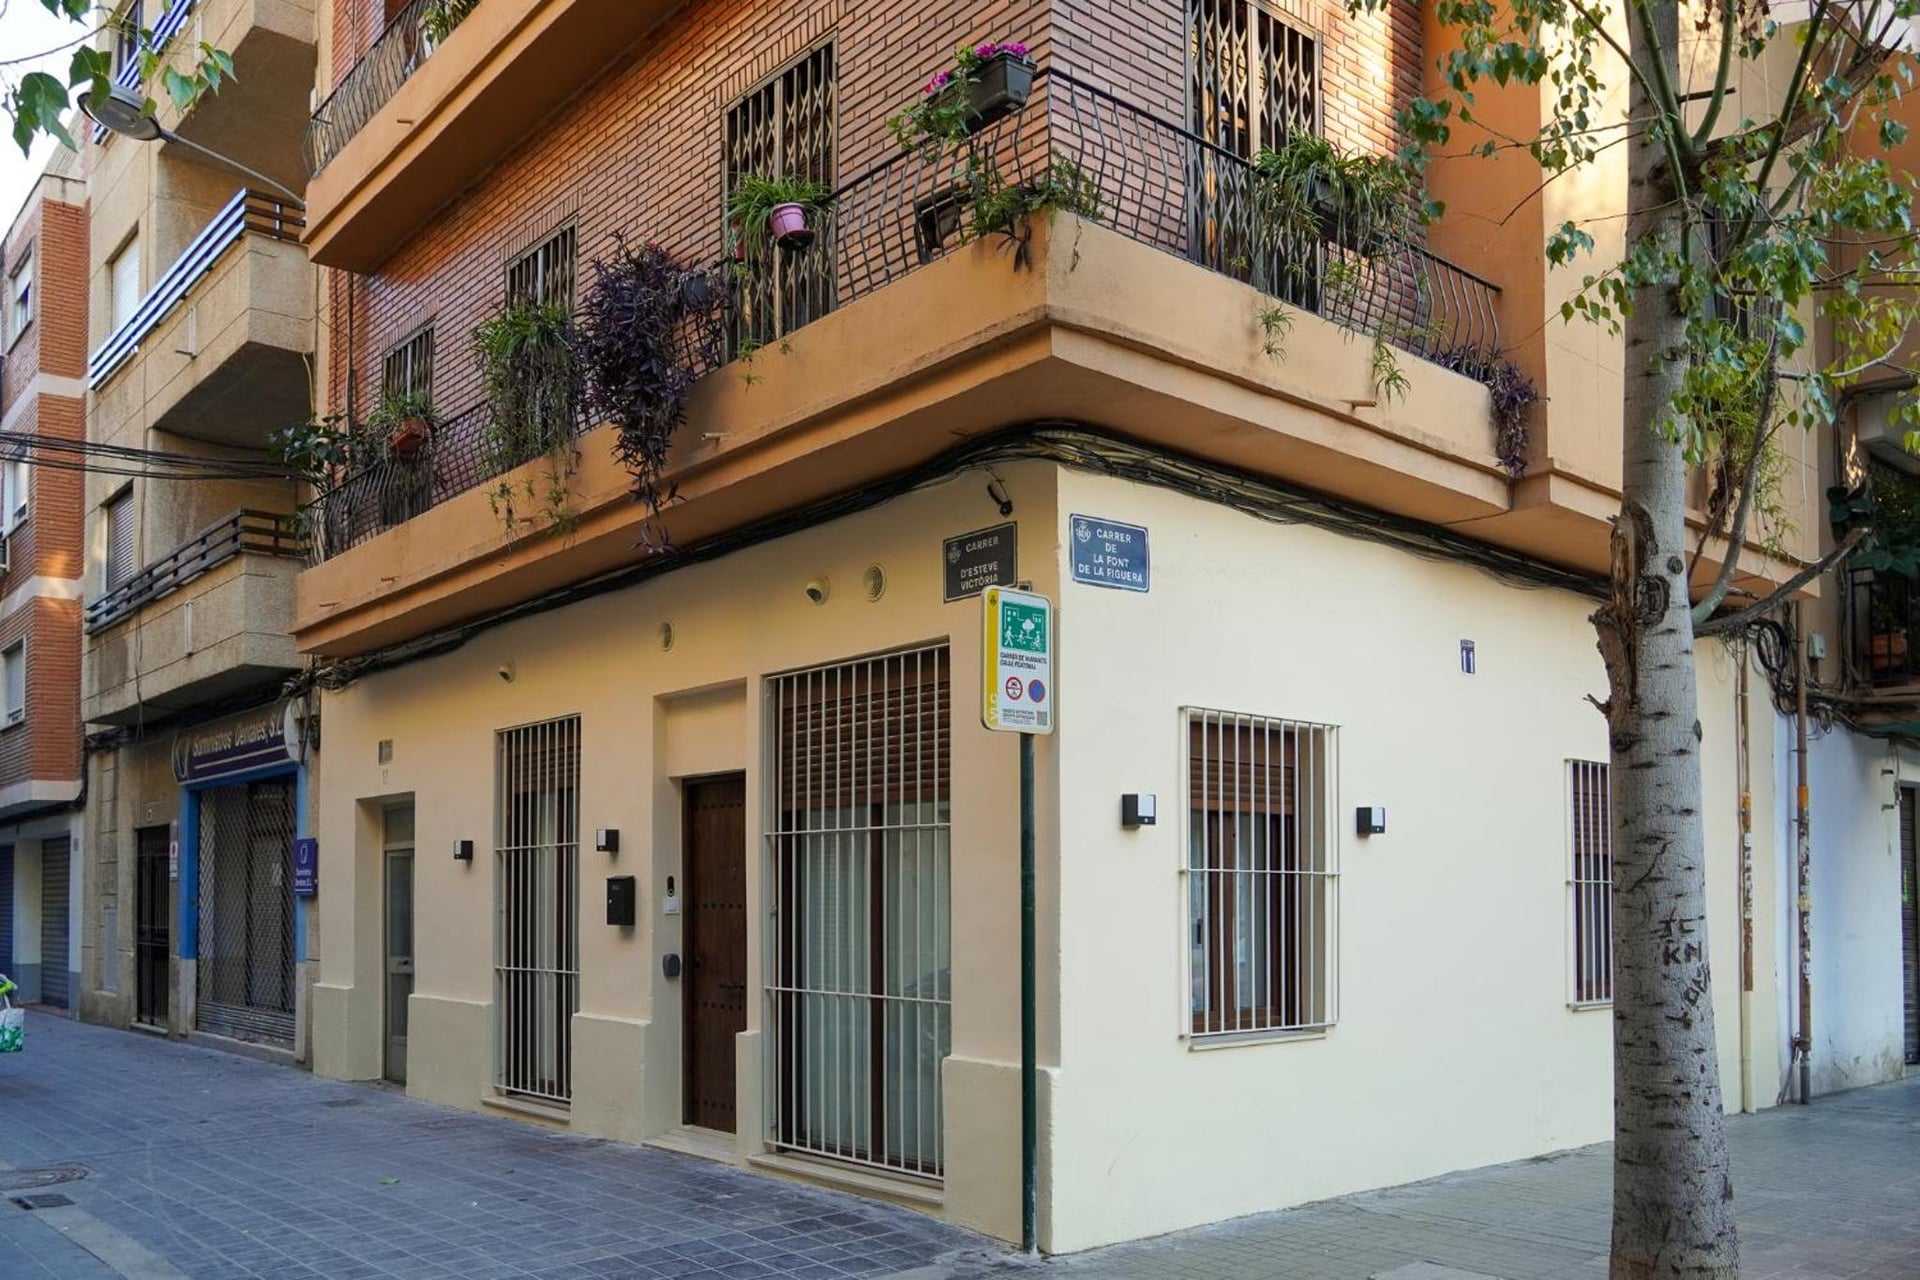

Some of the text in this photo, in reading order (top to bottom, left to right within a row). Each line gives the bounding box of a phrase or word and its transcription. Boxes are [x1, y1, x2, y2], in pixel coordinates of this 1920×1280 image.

[966, 536, 999, 552] CARRER
[1096, 528, 1132, 544] CARRER
[1105, 542, 1117, 554] DE
[1093, 553, 1130, 568] LA FONT
[960, 561, 999, 578] D'ESTEVE
[1078, 563, 1143, 583] DE LA FIGUERA
[1462, 649, 1474, 673] 11
